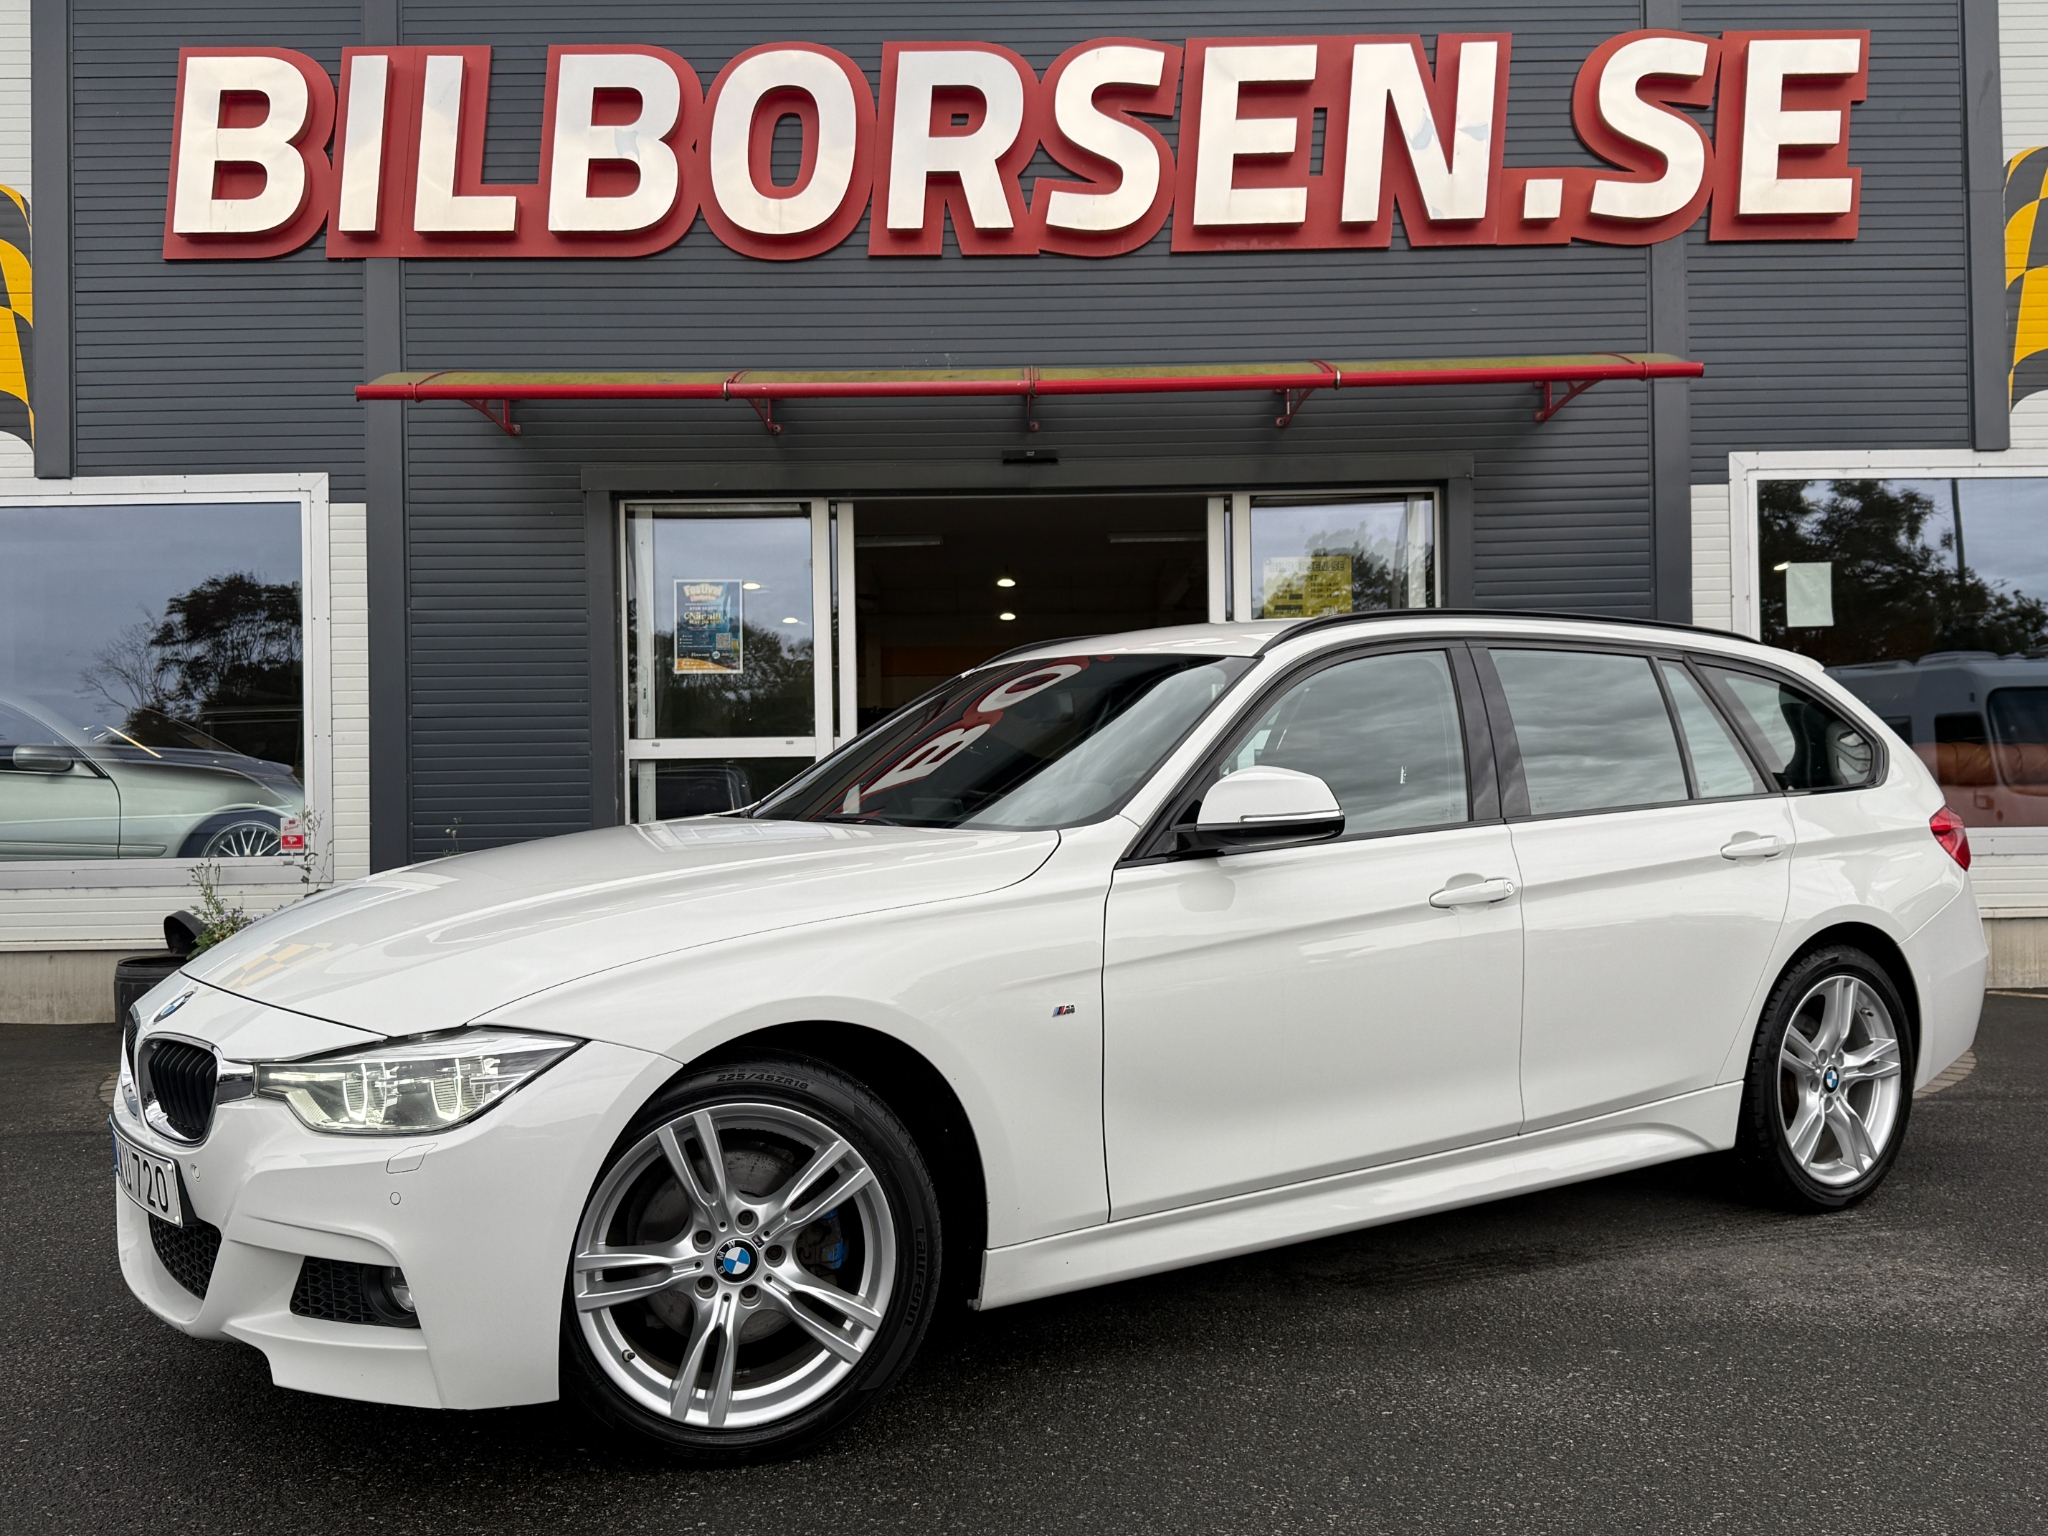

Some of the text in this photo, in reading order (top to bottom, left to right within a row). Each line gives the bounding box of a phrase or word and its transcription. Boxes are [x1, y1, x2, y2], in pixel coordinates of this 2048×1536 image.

[172, 37, 1861, 236] BILBORSEN.SE
[132, 1152, 169, 1213] 720
[716, 1239, 736, 1275] BMW
